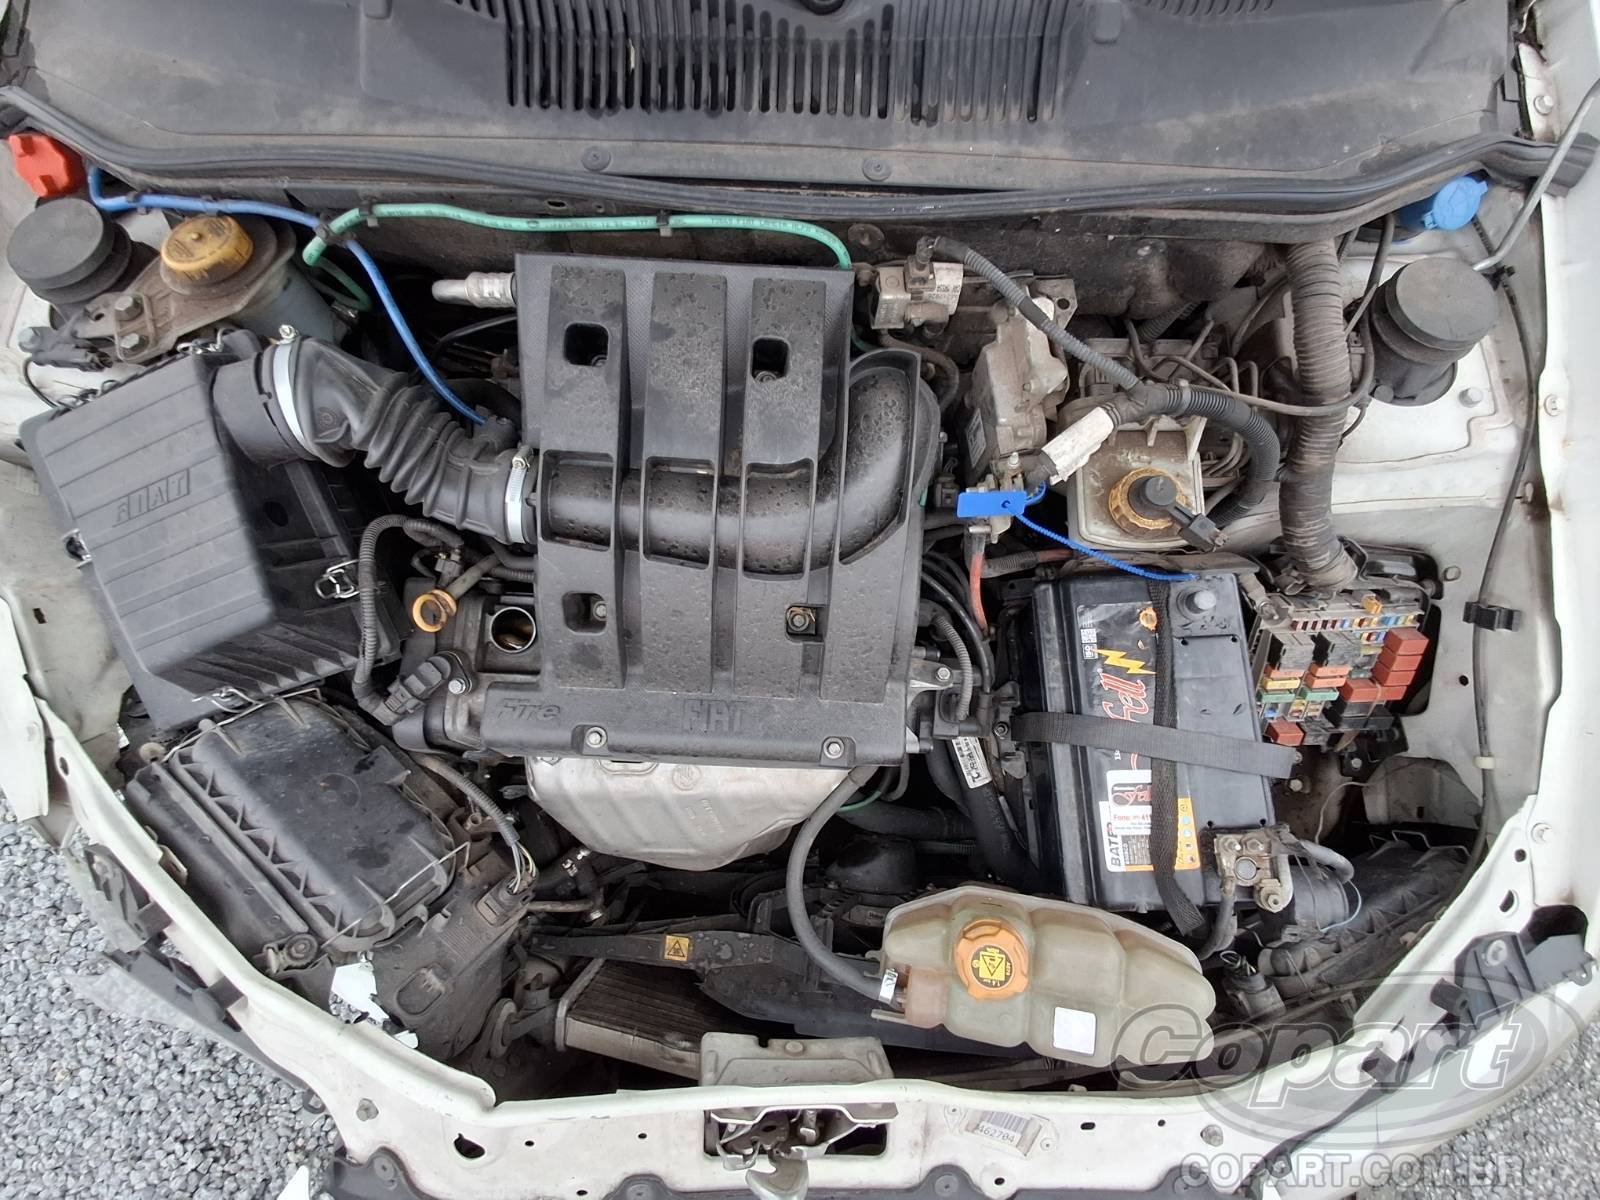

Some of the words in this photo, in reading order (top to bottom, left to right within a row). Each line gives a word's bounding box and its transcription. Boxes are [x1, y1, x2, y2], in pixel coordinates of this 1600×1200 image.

[115, 470, 190, 526] FIAT
[682, 699, 748, 733] FIAT
[978, 1125, 1015, 1144] 462704
